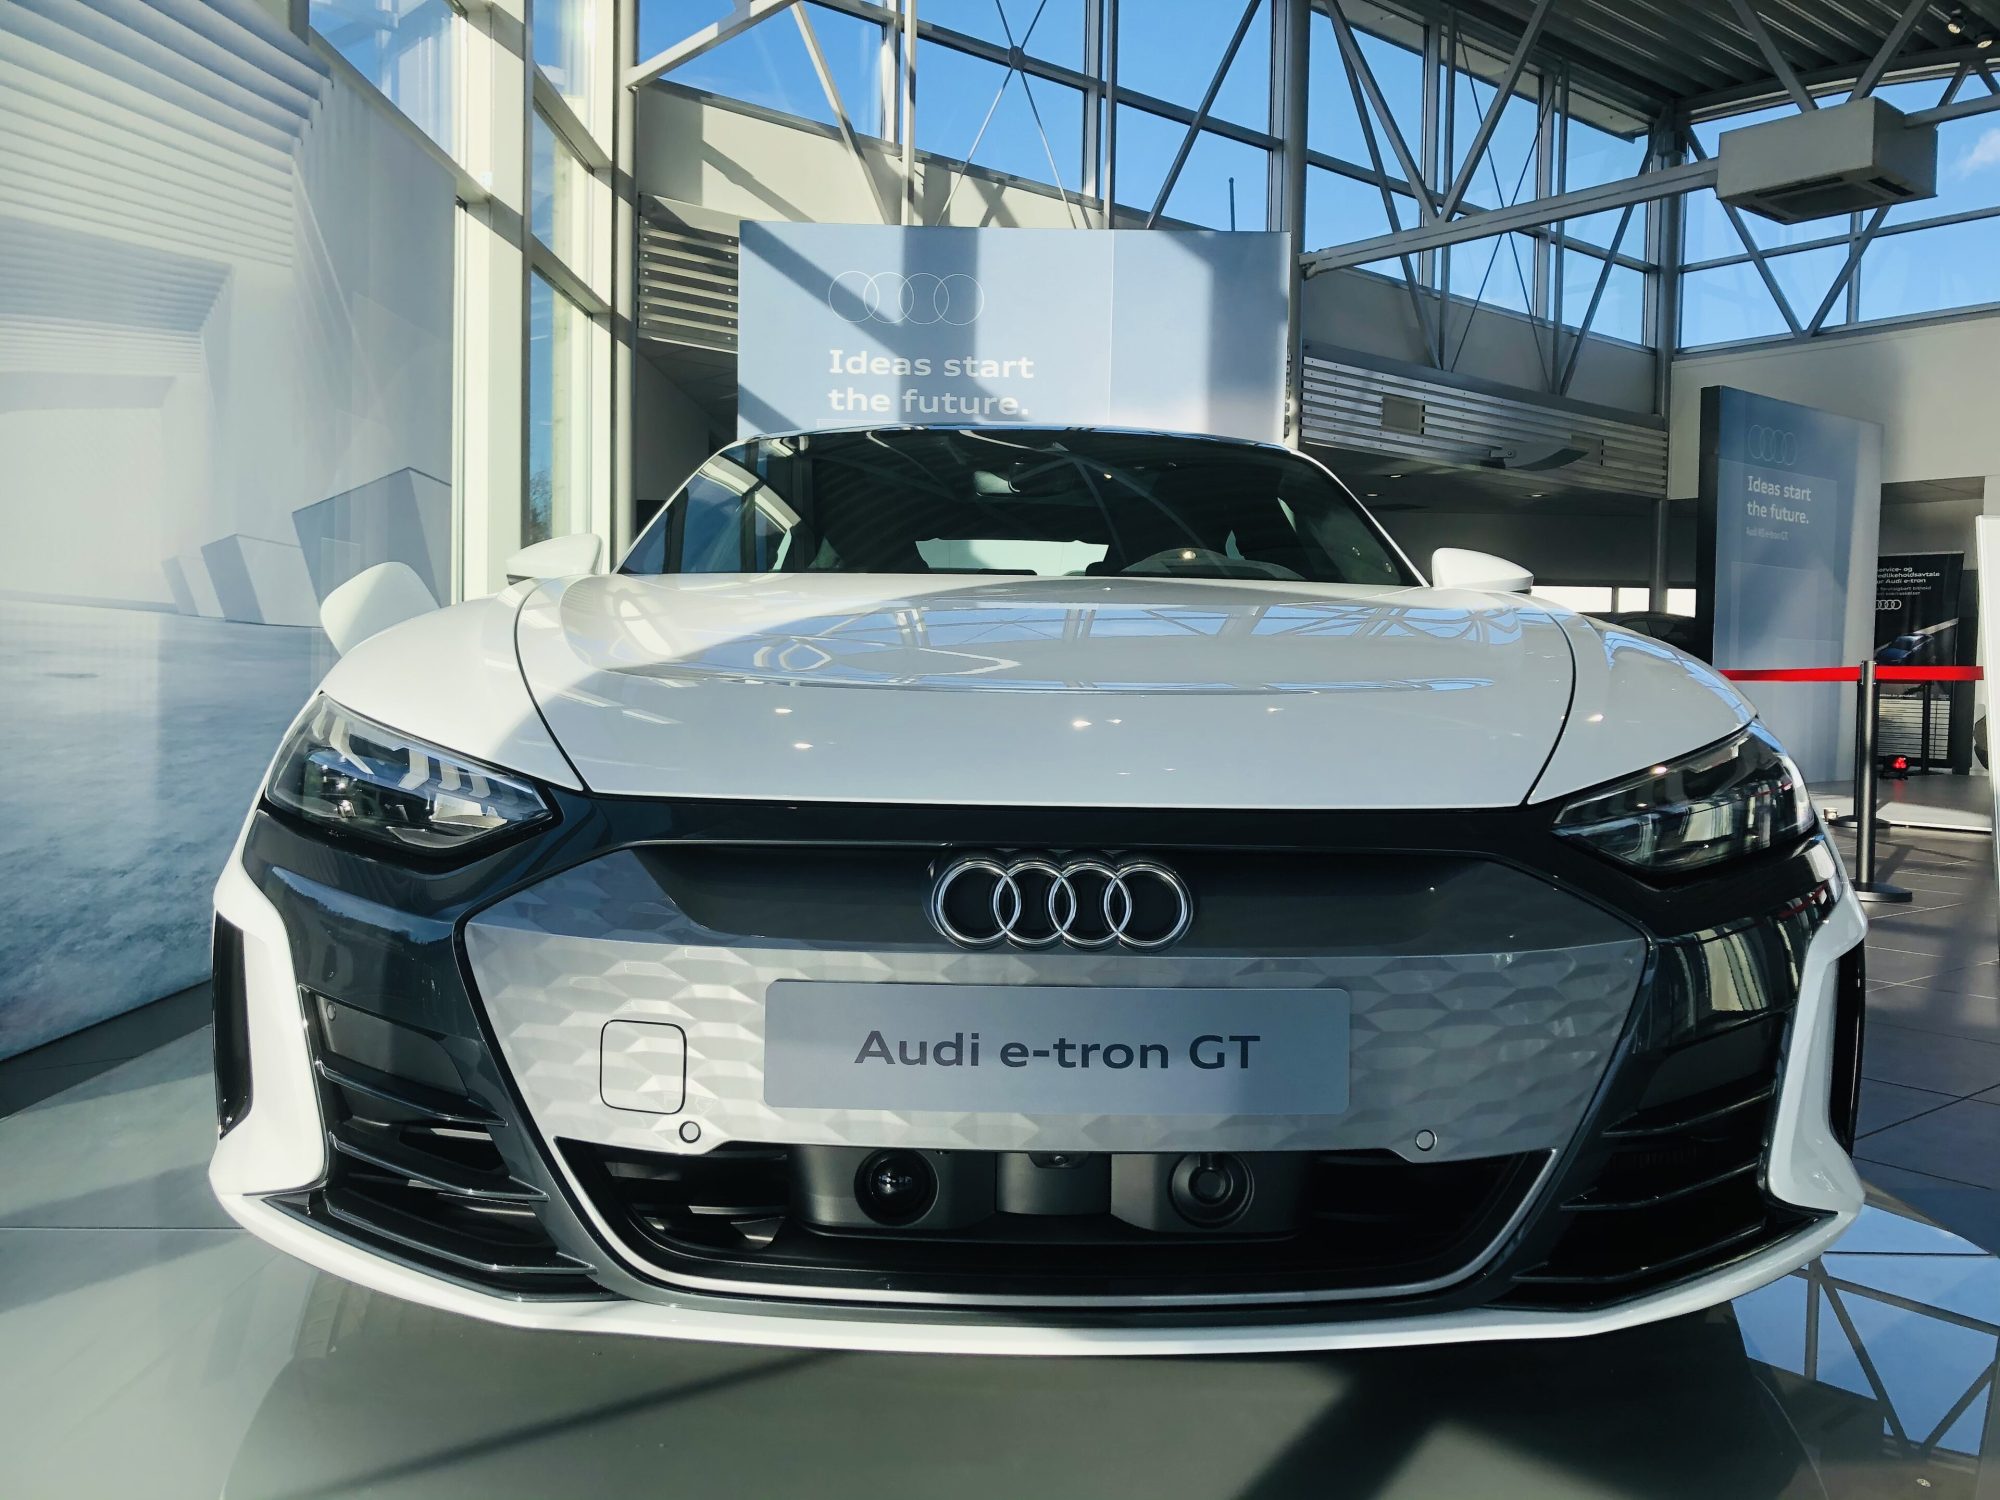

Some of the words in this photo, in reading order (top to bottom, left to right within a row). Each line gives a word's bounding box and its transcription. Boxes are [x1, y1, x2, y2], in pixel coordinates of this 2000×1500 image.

[829, 350, 931, 376] Ideas
[943, 355, 1034, 378] start
[828, 387, 891, 412] the
[902, 389, 1030, 416] future.
[1748, 476, 1780, 496] Ideas
[1783, 485, 1811, 501] start
[1747, 500, 1767, 517] the
[1770, 503, 1809, 524] future.
[854, 1030, 980, 1067] Audi
[1000, 1036, 1169, 1069] e-tron
[1189, 1034, 1261, 1069] GT
